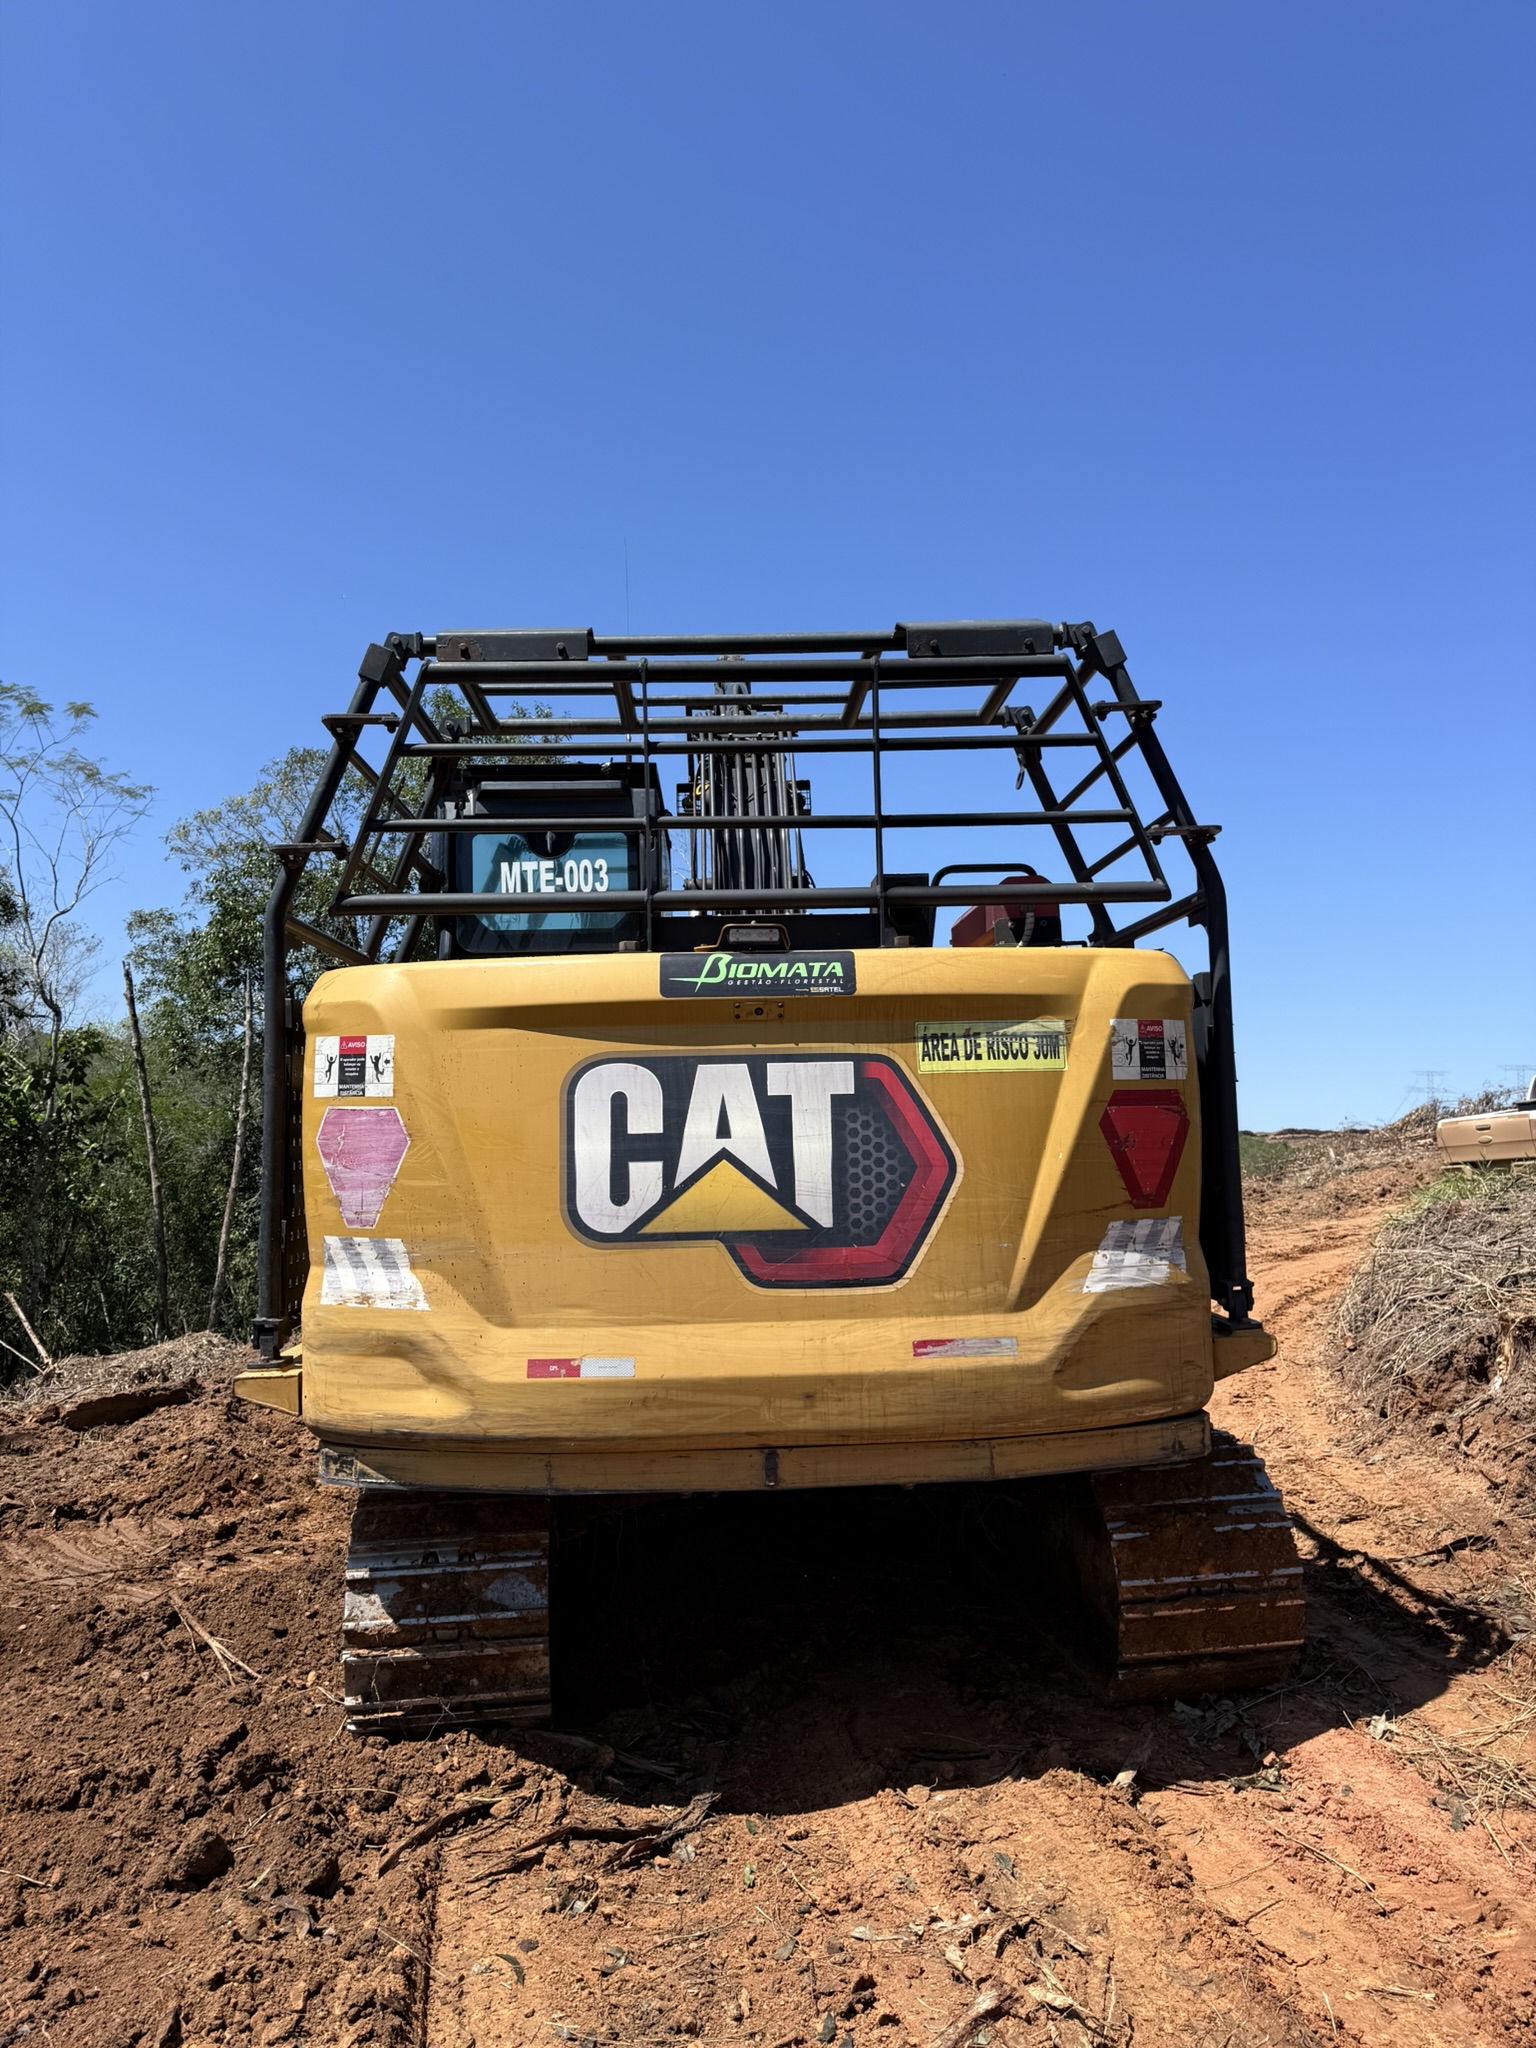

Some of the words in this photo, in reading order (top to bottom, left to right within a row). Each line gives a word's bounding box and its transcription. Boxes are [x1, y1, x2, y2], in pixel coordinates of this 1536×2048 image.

[500, 858, 609, 894] MTE-003
[692, 953, 844, 993] BIOMATA
[964, 1032, 983, 1061] DE
[574, 1061, 855, 1235] CAT
